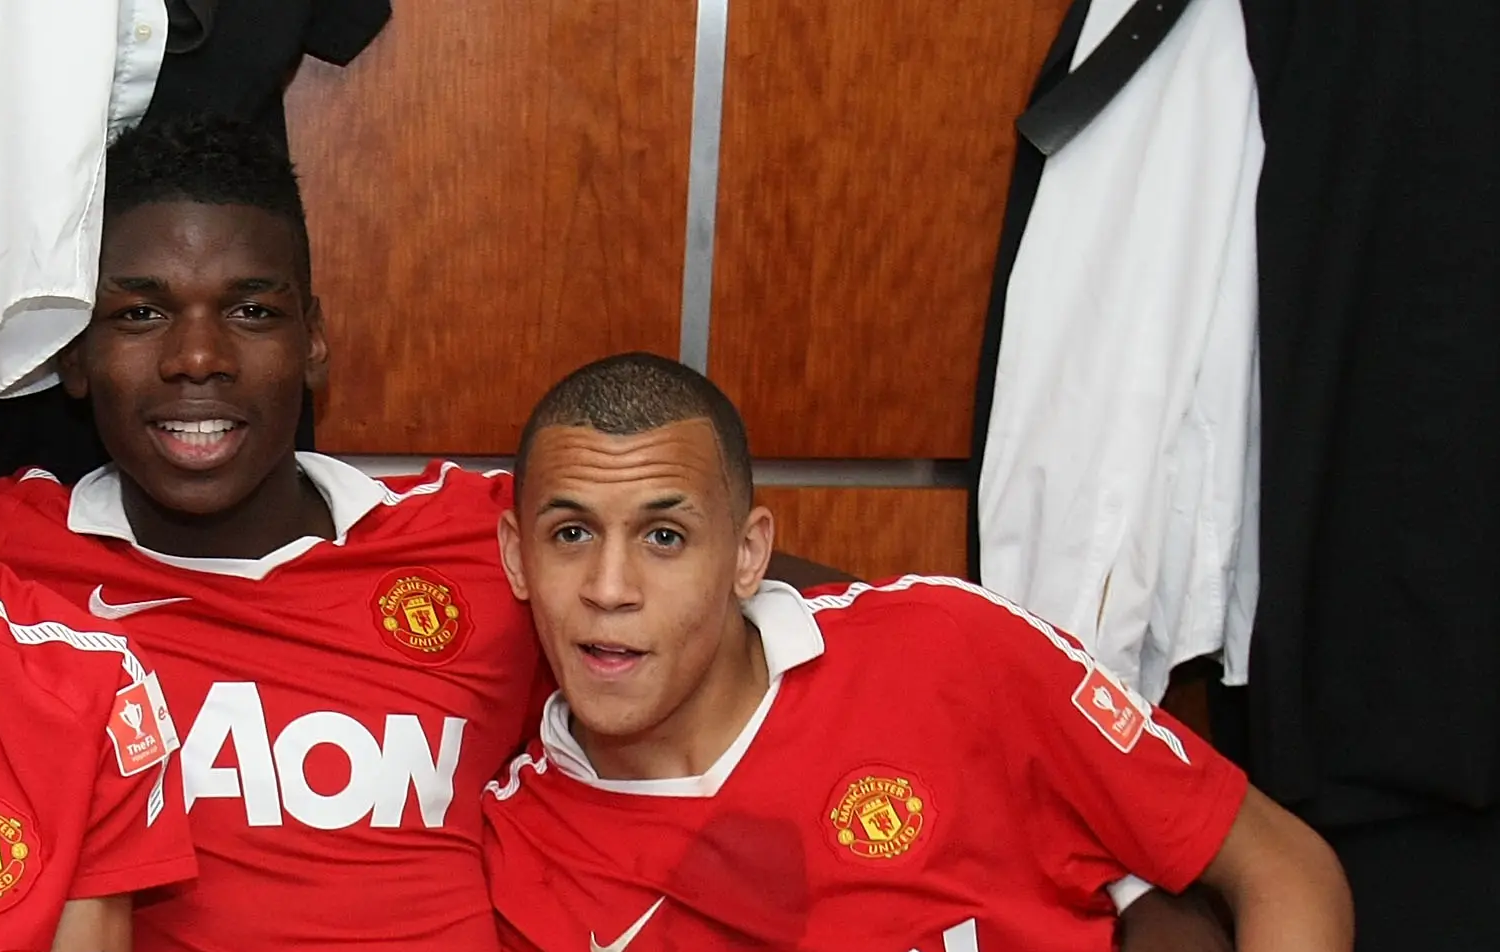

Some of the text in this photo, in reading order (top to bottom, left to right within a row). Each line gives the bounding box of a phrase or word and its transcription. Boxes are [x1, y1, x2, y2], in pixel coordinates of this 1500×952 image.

[386, 582, 446, 611] MANCHESTER
[409, 630, 451, 647] UNITED
[180, 681, 468, 829] AON
[839, 782, 905, 823] MANCHESTER
[869, 826, 915, 855] UNITED
